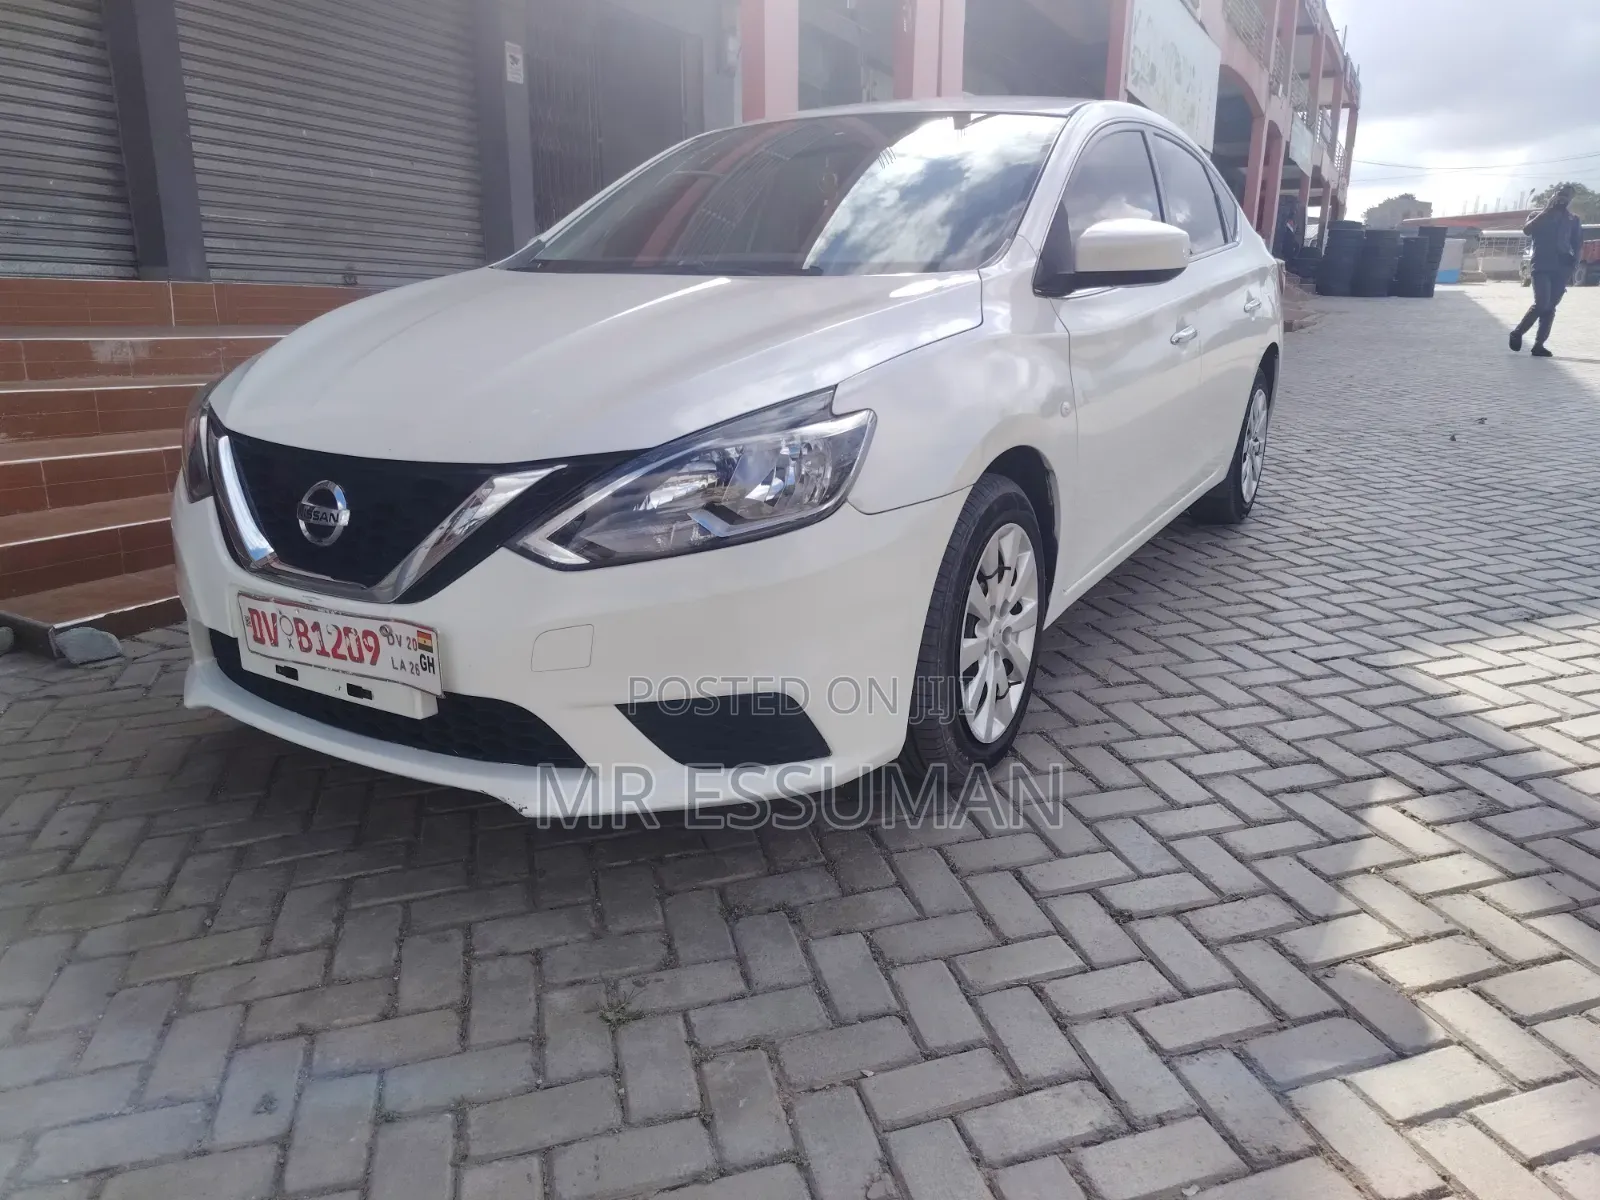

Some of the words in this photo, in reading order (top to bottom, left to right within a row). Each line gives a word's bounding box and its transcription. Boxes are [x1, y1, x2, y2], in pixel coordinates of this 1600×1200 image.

[298, 503, 339, 523] NISSAN
[248, 607, 279, 647] DV
[293, 616, 381, 666] B1209
[391, 656, 407, 672] LA
[419, 653, 436, 675] GH
